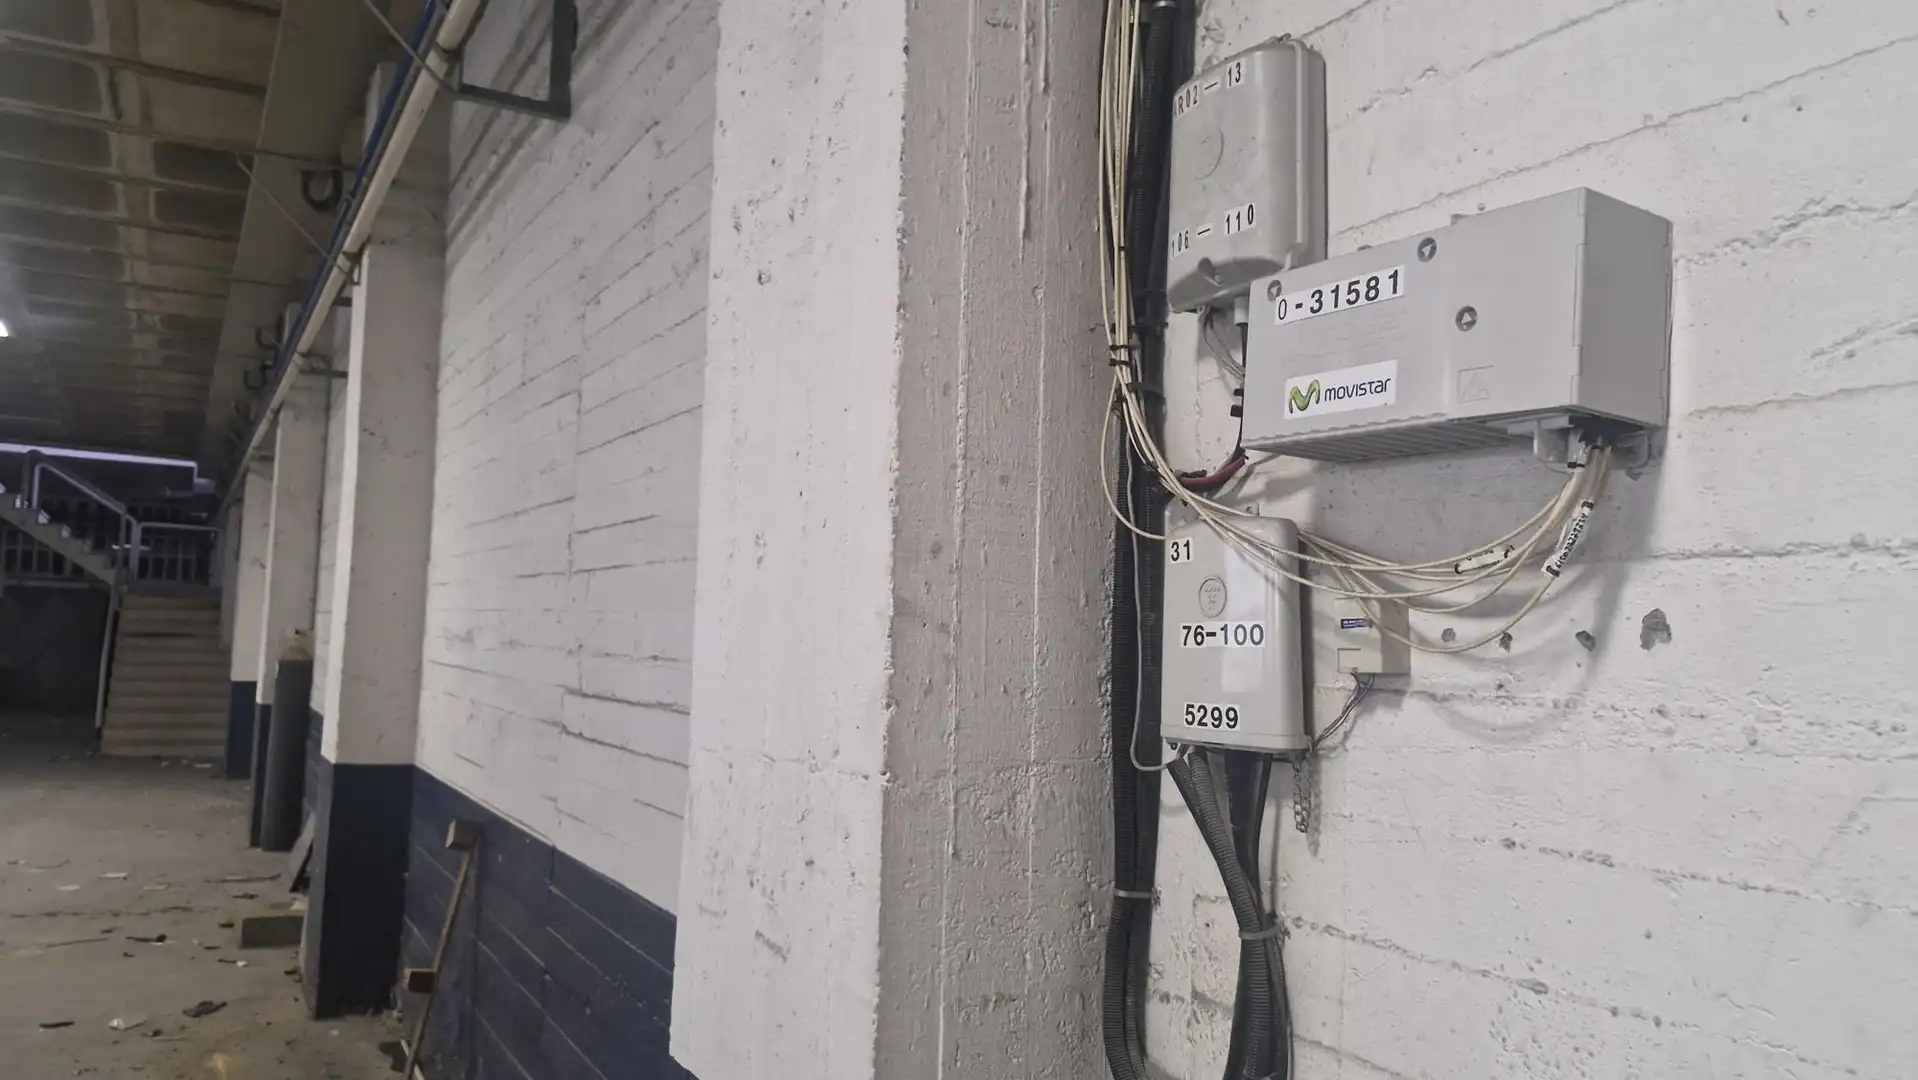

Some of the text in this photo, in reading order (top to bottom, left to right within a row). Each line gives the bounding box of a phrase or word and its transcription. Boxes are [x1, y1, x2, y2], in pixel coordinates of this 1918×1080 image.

[1228, 62, 1241, 87] 13
[1171, 230, 1189, 258] 106
[1225, 203, 1255, 235] 110
[1170, 539, 1192, 562] 31
[1182, 623, 1265, 647] 76-100
[1184, 703, 1239, 730] 5299
